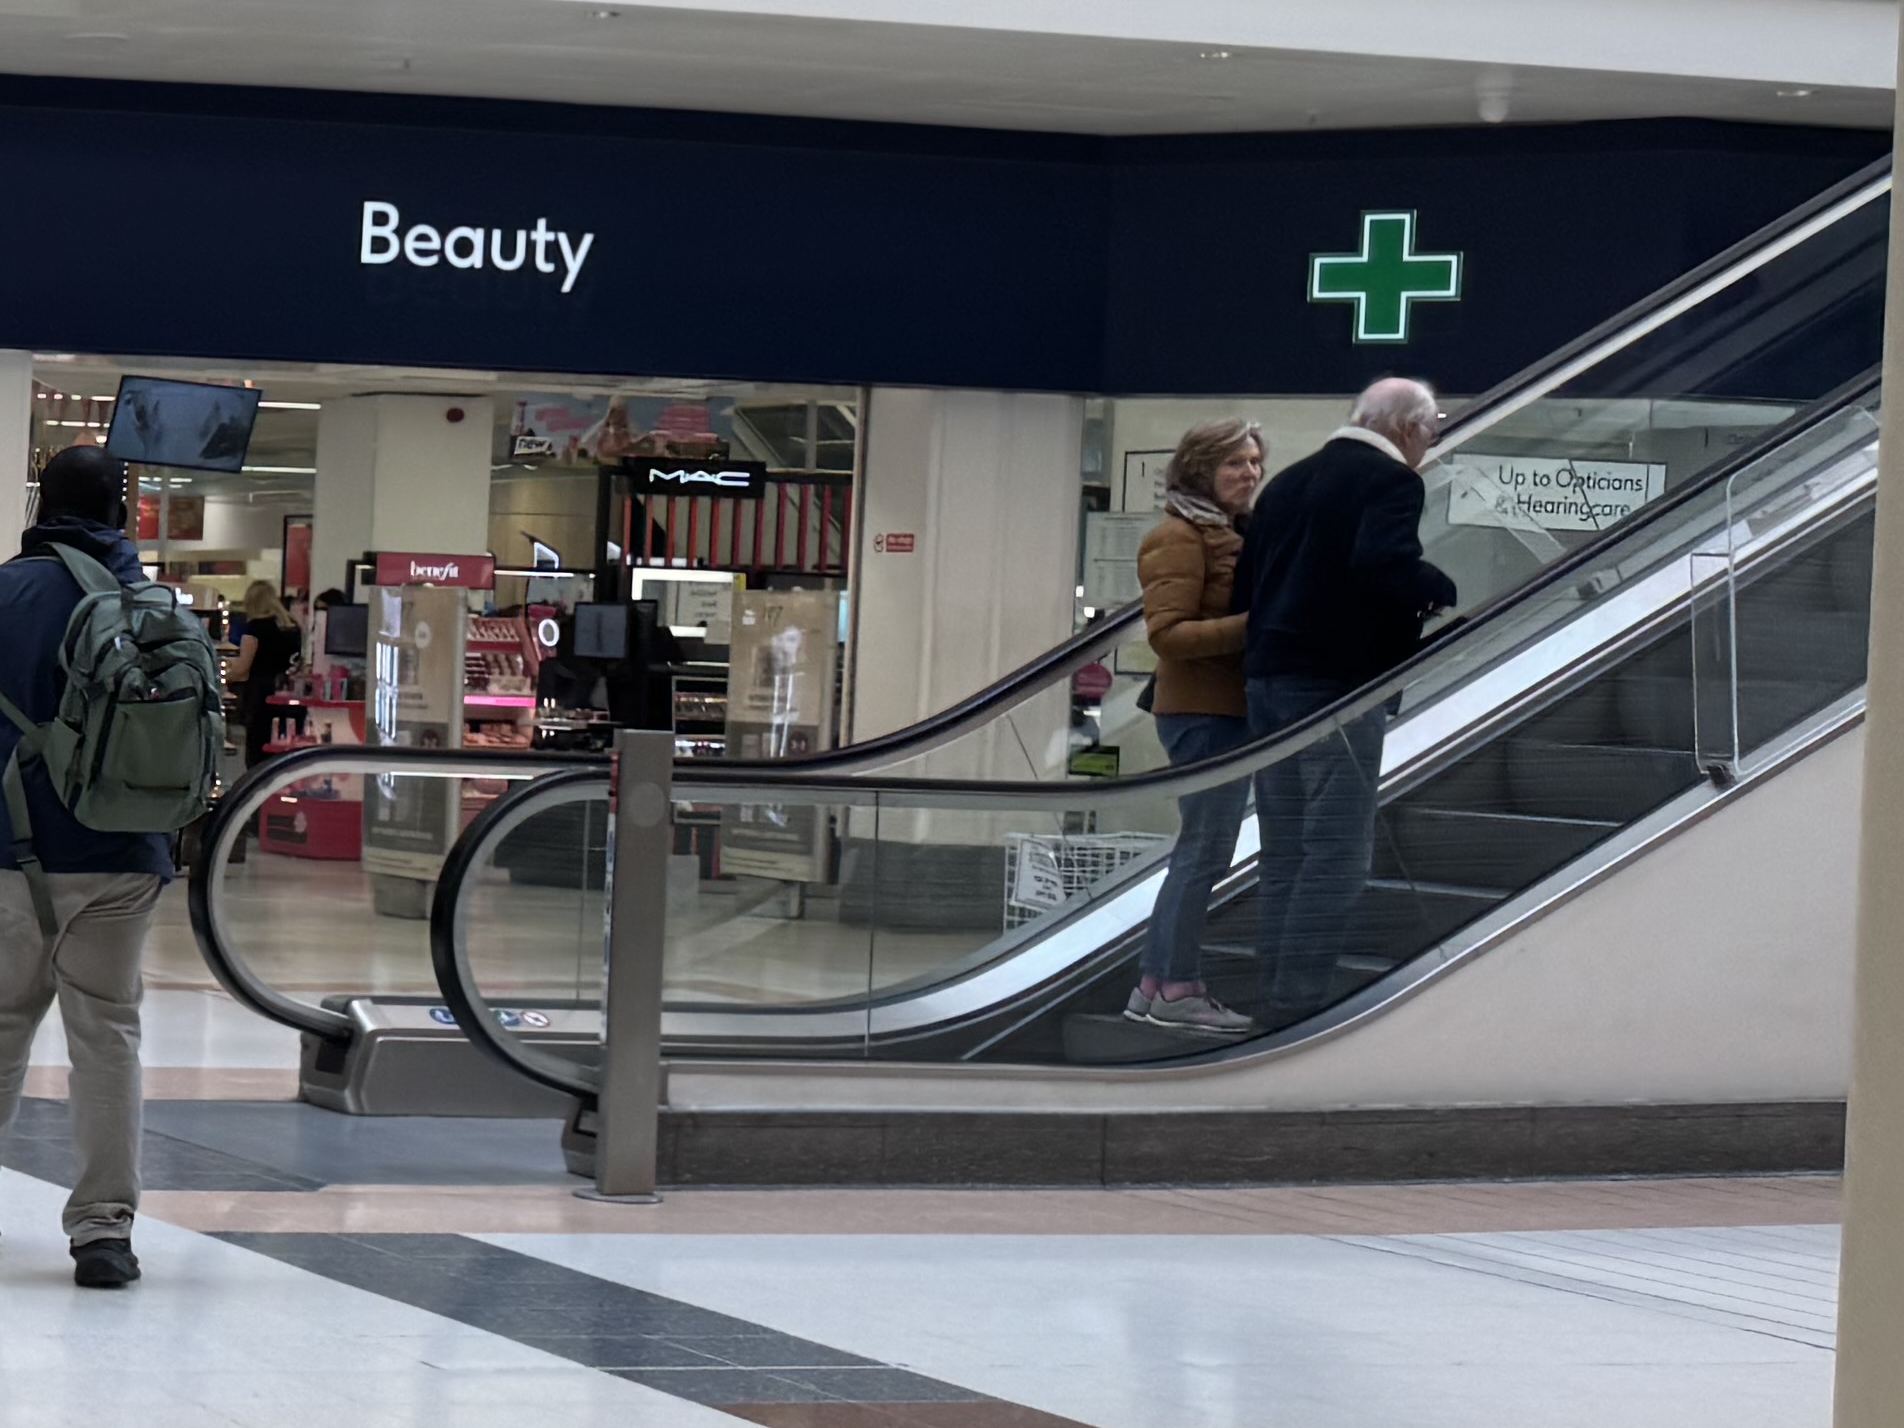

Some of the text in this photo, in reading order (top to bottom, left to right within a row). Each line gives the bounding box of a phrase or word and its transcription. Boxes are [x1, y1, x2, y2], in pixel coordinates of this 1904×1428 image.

[360, 201, 595, 294] Beauty
[1498, 464, 1644, 495] Up to Opticians
